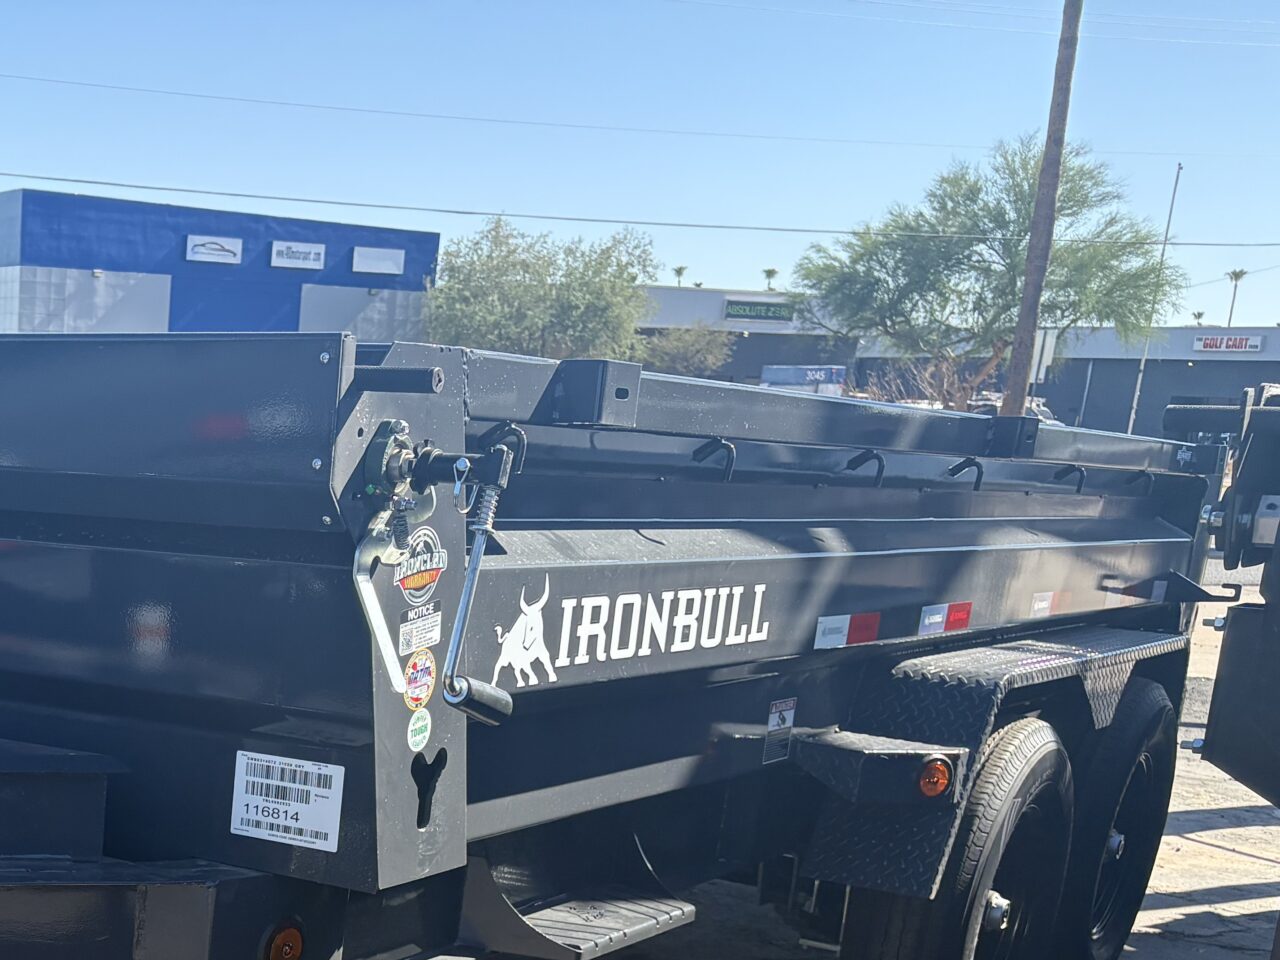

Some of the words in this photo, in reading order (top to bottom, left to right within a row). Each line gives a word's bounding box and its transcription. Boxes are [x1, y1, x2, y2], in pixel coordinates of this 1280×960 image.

[727, 305, 767, 316] ABSOLUTE
[1203, 337, 1224, 349] GOLF
[1225, 337, 1249, 349] CART
[805, 371, 826, 381] 3045
[408, 603, 435, 621] NOTICE
[554, 583, 769, 668] IRONBULL
[410, 723, 428, 739] TOUGH
[243, 803, 300, 823] 116814
